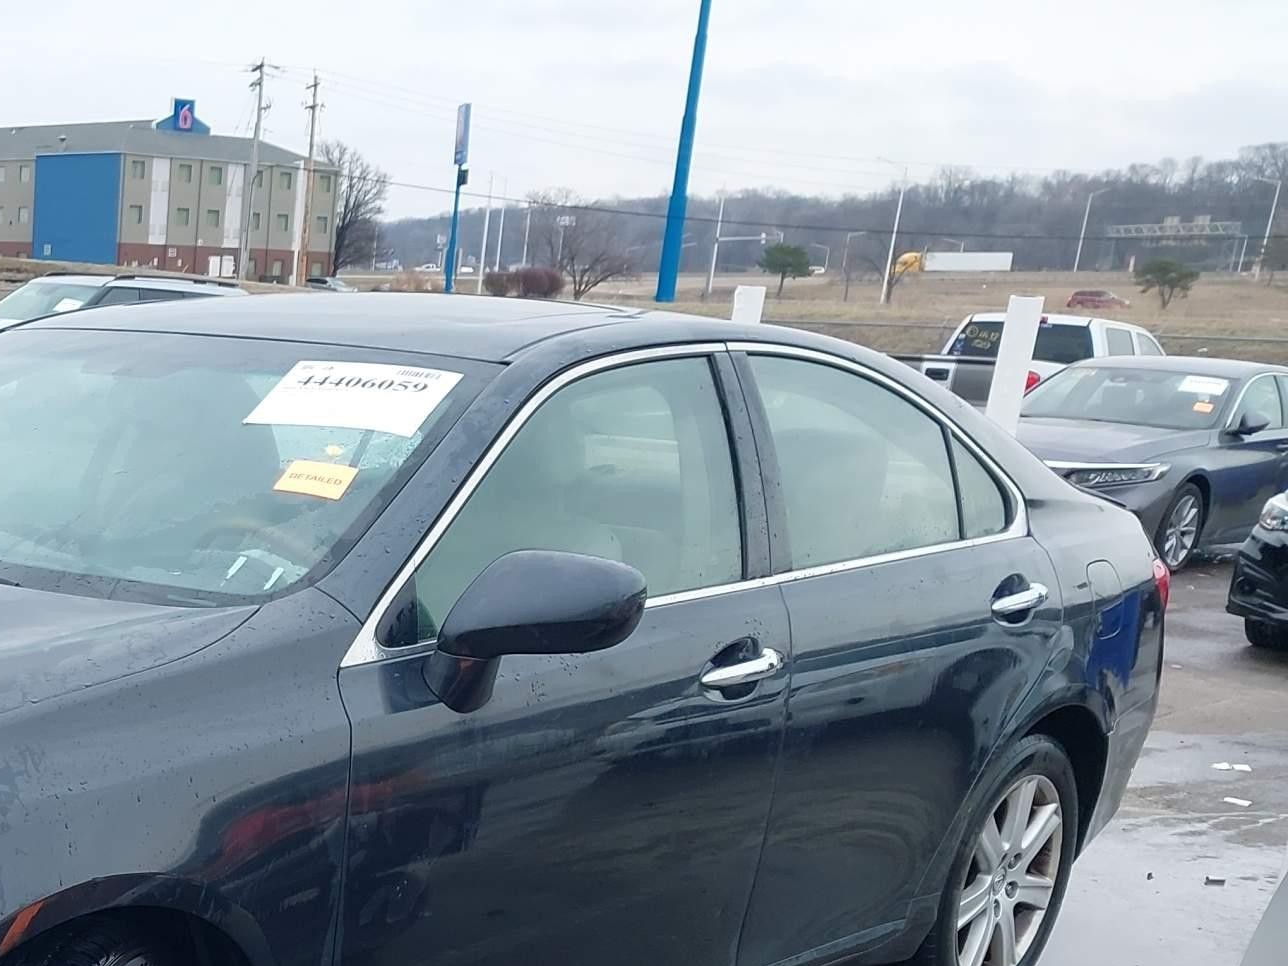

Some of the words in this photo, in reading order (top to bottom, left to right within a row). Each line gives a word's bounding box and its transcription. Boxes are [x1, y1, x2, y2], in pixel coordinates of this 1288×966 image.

[179, 103, 192, 128] 6
[297, 375, 429, 393] 44406059
[288, 472, 343, 487] DETAILED
